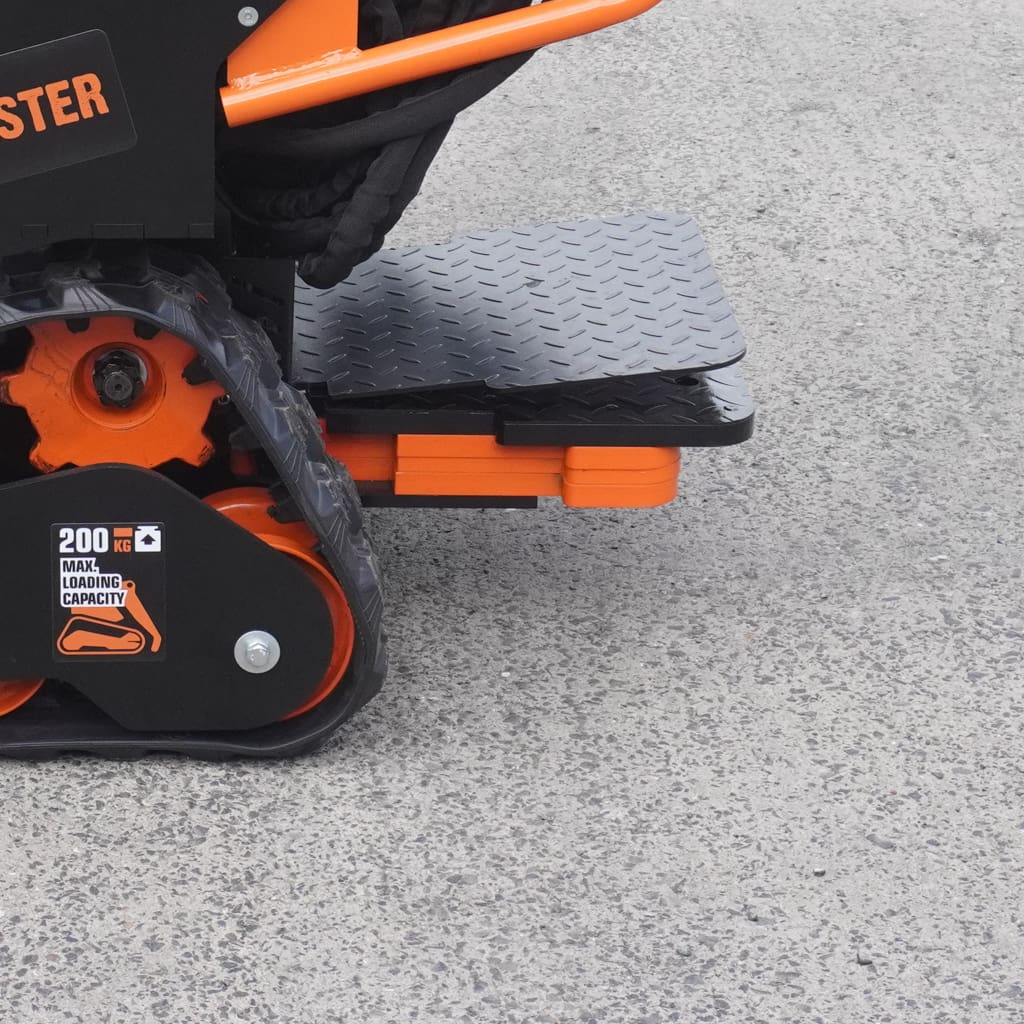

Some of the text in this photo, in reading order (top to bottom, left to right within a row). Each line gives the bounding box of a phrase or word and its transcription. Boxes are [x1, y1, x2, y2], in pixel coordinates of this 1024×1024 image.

[59, 527, 131, 553] 200 KG
[62, 560, 97, 573] MAX.
[63, 576, 120, 589] LOADING
[63, 592, 125, 605] CAPACITY
